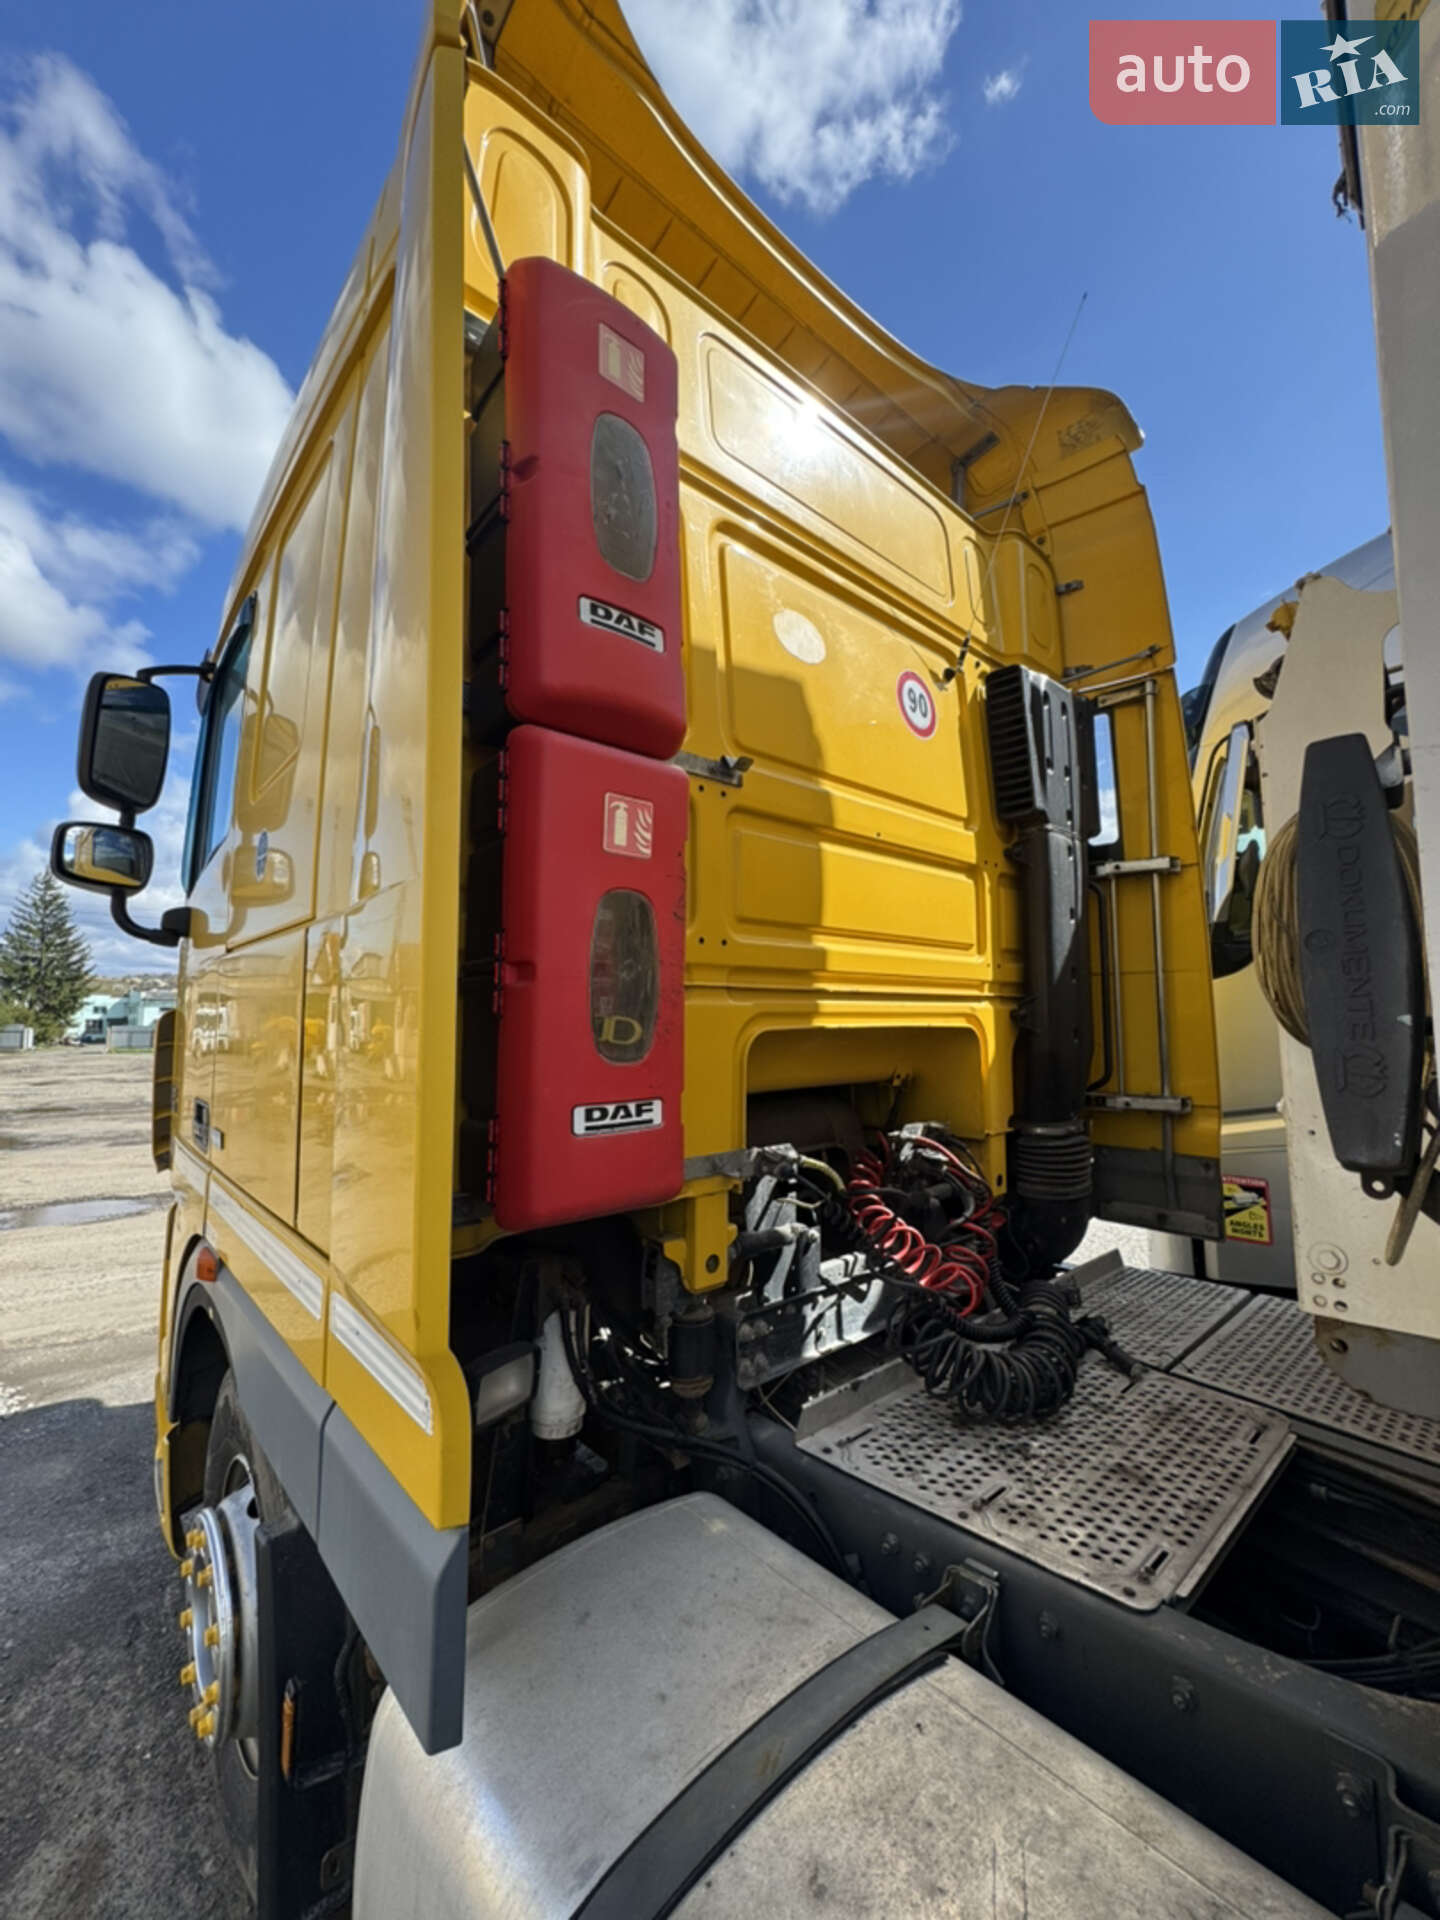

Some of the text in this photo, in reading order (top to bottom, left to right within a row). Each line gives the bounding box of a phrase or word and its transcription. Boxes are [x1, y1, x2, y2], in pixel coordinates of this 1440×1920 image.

[589, 602, 656, 638] DAF
[907, 687, 929, 719] 90
[1335, 846, 1377, 1043] DOKUMENTE
[584, 1101, 654, 1123] DAF
